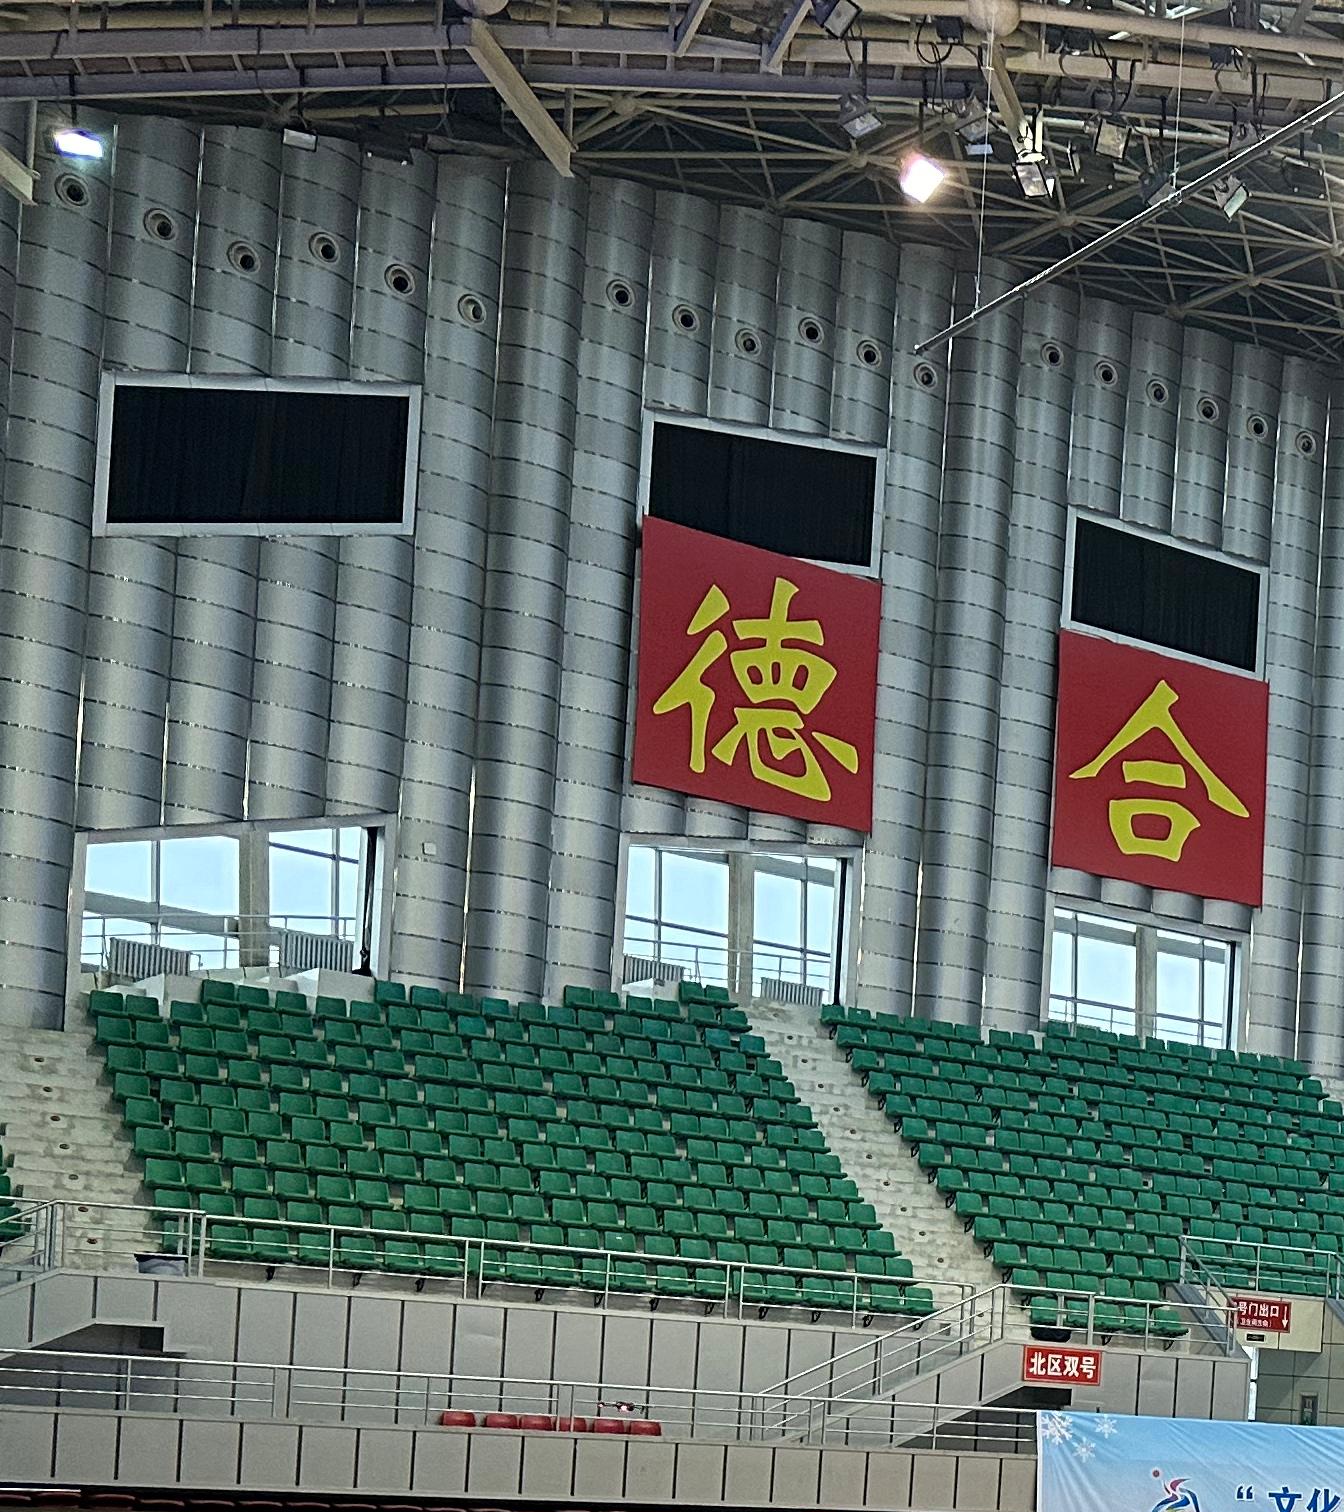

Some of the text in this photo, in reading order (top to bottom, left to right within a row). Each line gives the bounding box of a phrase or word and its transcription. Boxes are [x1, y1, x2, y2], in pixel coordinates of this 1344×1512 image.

[652, 577, 860, 802] 德
[1069, 680, 1250, 863] 合
[1231, 1301, 1279, 1317] 号门出口
[1029, 1352, 1097, 1379] 北区双号
